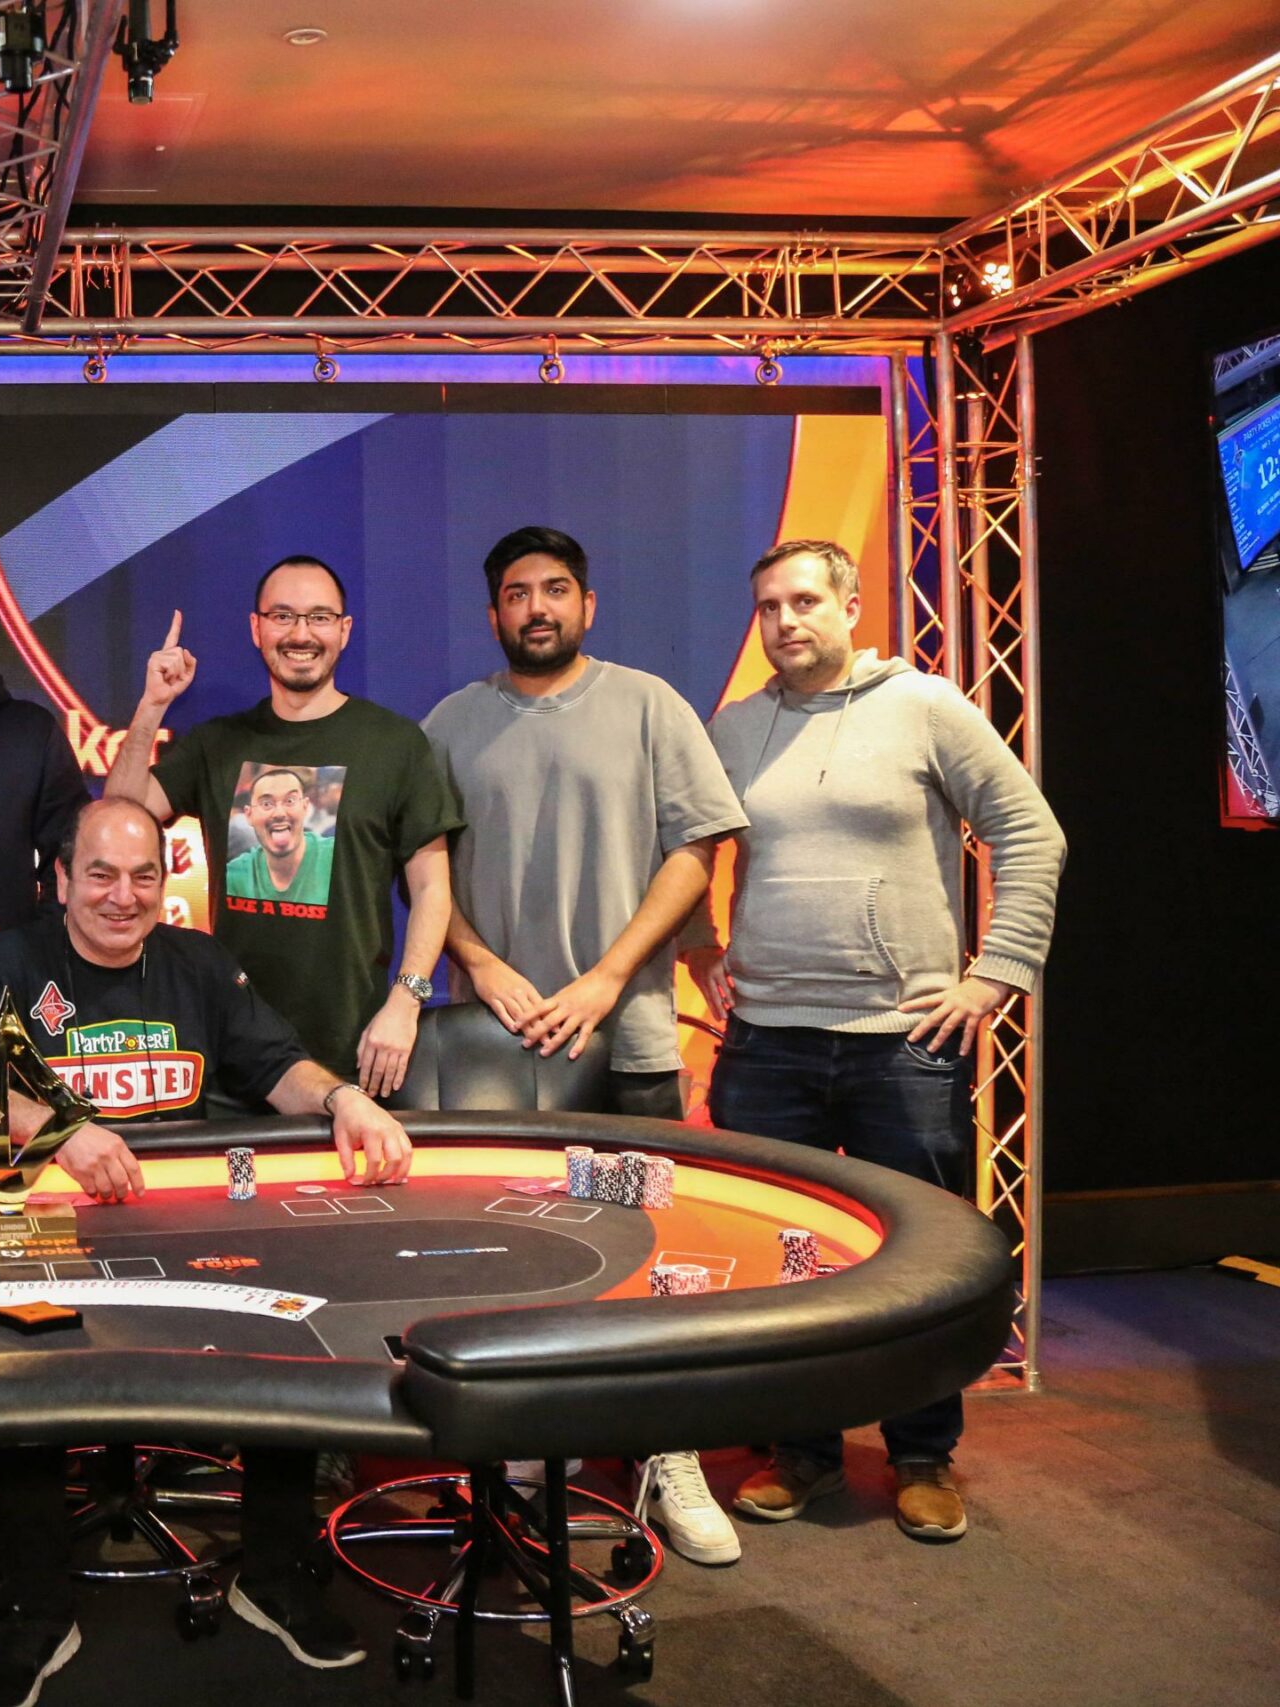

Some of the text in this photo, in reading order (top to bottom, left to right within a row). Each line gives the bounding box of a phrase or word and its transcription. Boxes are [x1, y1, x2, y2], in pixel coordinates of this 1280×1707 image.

[1258, 448, 1280, 489] 12:
[226, 897, 328, 920] LIKE A BOSS
[58, 1067, 190, 1101] ONSTER
